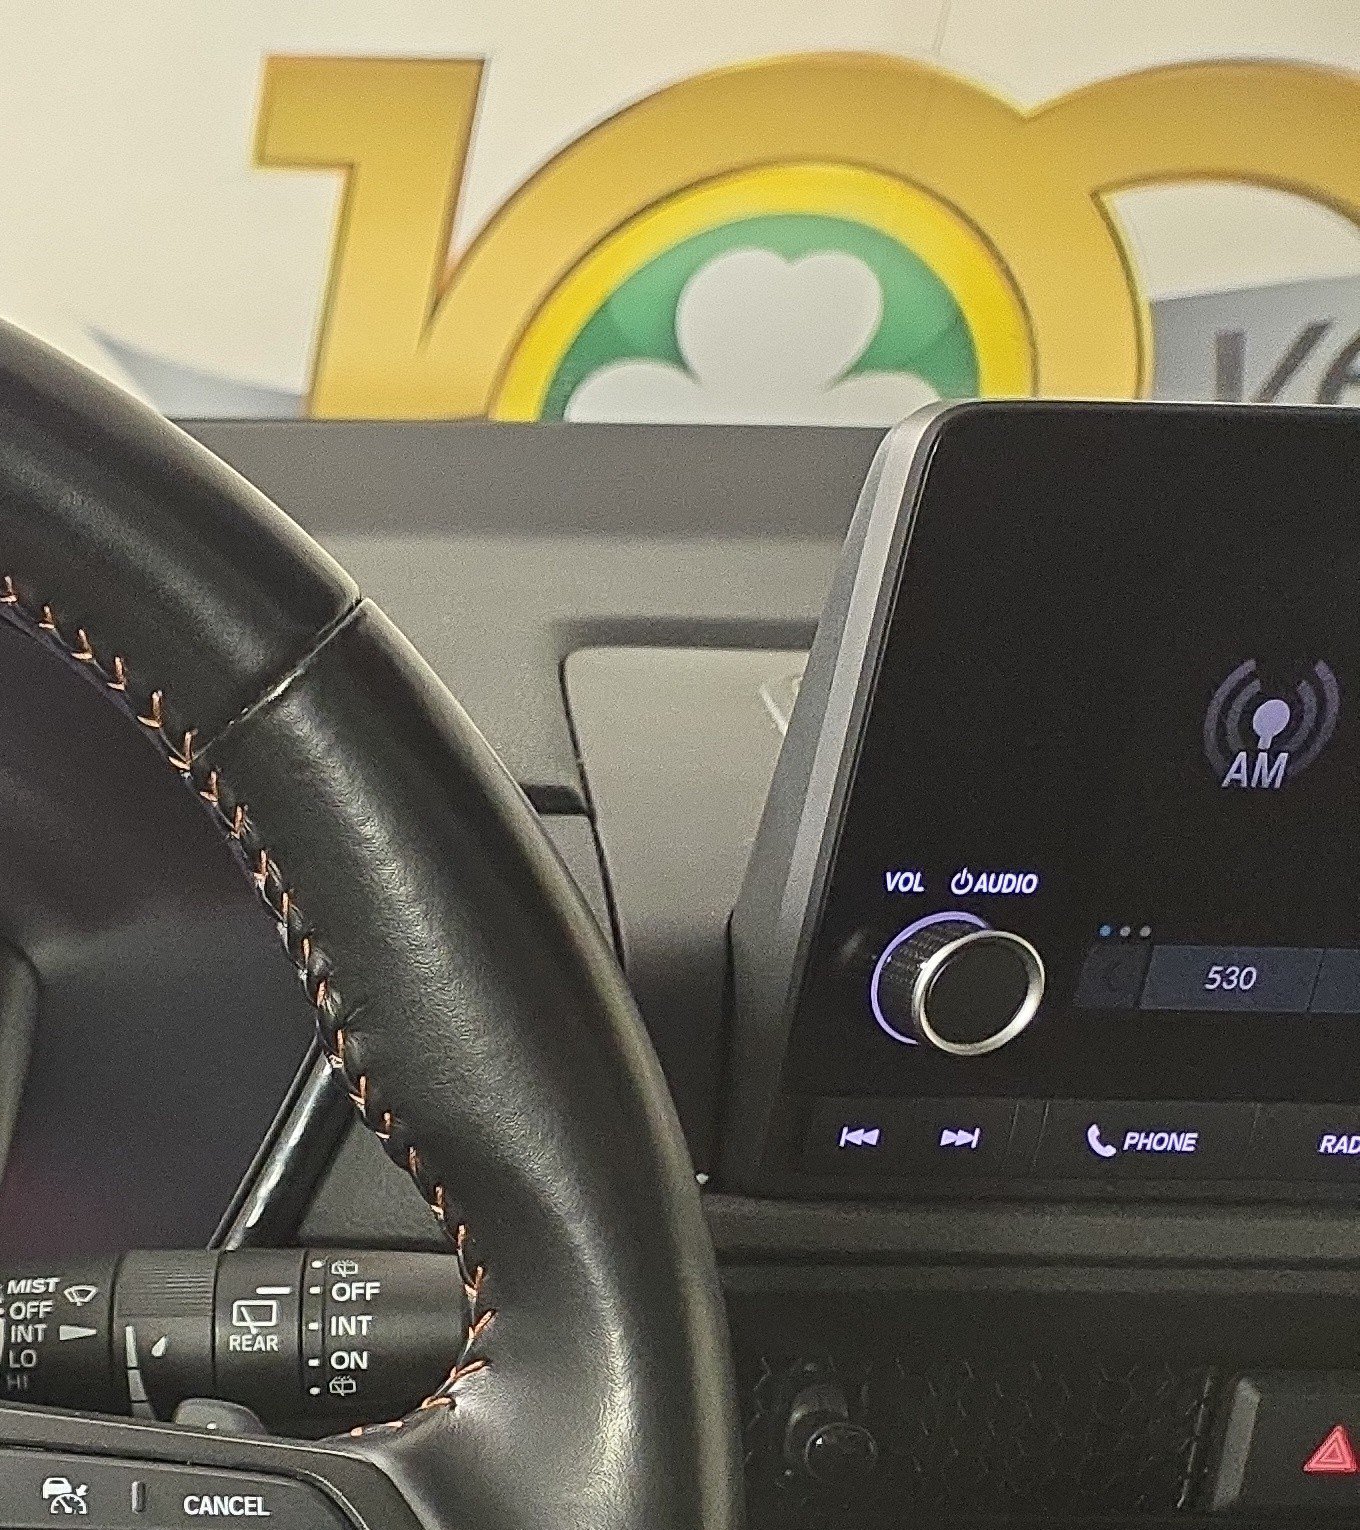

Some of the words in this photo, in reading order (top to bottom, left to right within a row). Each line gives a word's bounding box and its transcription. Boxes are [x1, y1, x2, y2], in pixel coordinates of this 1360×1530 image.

[1221, 751, 1289, 789] AM
[885, 872, 925, 893] VOL
[973, 873, 1039, 895] AUDIO
[1204, 967, 1257, 990] 530
[1123, 1132, 1198, 1152] PHONE
[7, 1277, 60, 1295] MIST
[331, 1282, 380, 1302] OFF
[9, 1302, 52, 1320] OFF
[11, 1325, 46, 1343] INT
[330, 1316, 373, 1335] INT
[229, 1335, 278, 1352] REAR
[8, 1350, 37, 1369] LO
[330, 1351, 369, 1370] ON
[183, 1496, 271, 1517] CANCEL
